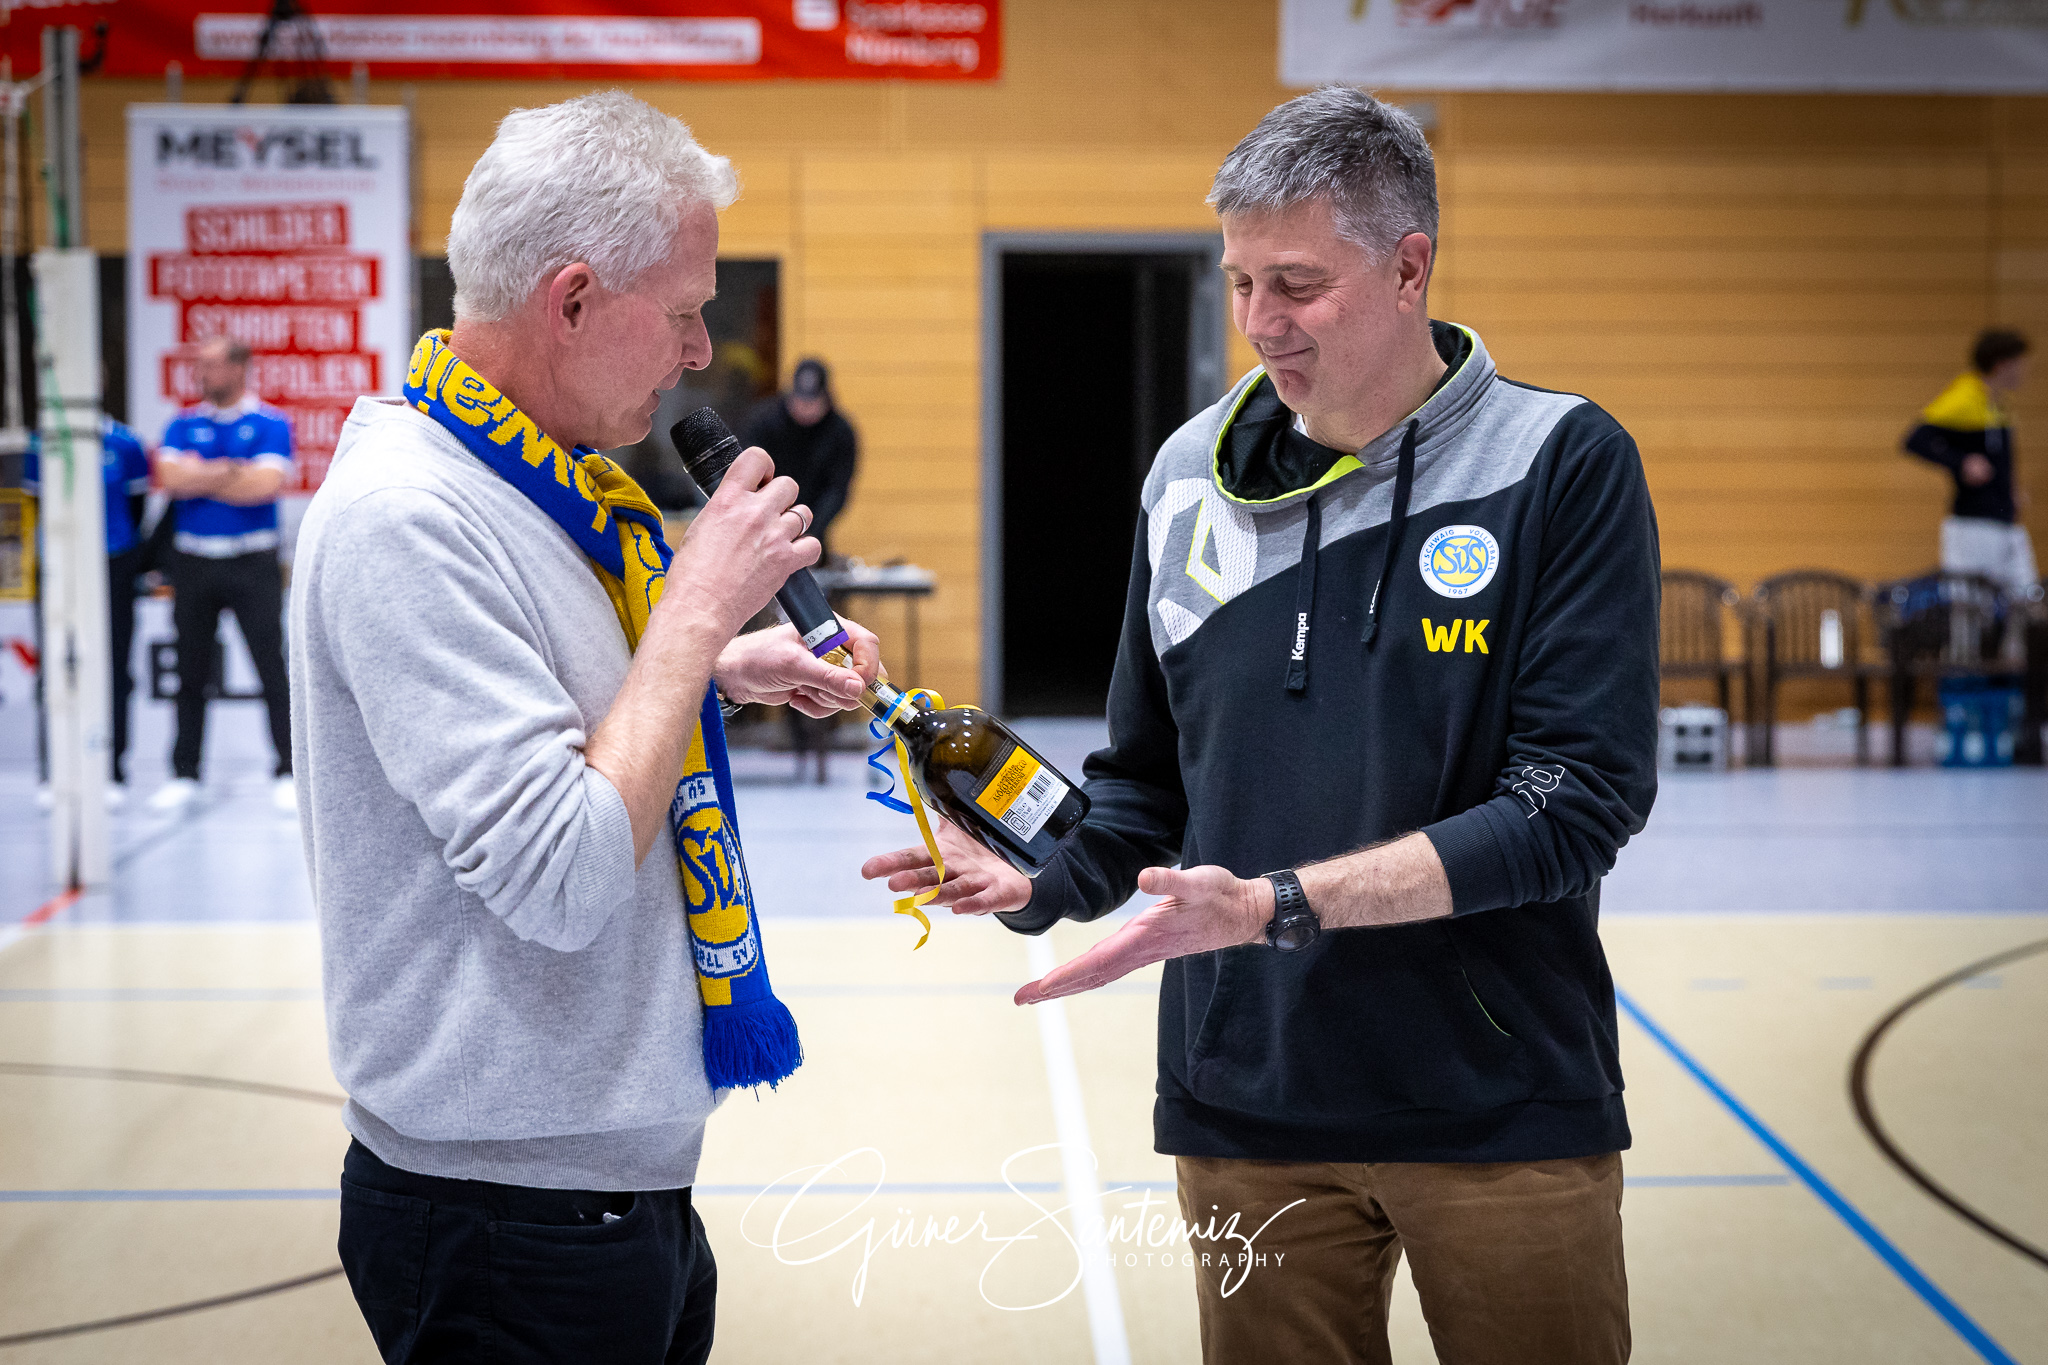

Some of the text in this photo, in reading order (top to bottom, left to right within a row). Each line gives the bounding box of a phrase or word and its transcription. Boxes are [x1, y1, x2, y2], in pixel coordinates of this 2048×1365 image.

[156, 127, 378, 169] MEYSEL
[194, 211, 338, 247] SCHILDER
[1425, 529, 1455, 559] SCHWAIG
[1469, 529, 1496, 571] VOLLEYBALL
[1291, 612, 1310, 661] Kempa
[1421, 618, 1490, 654] WK
[1004, 758, 1028, 785] PROSECCO
